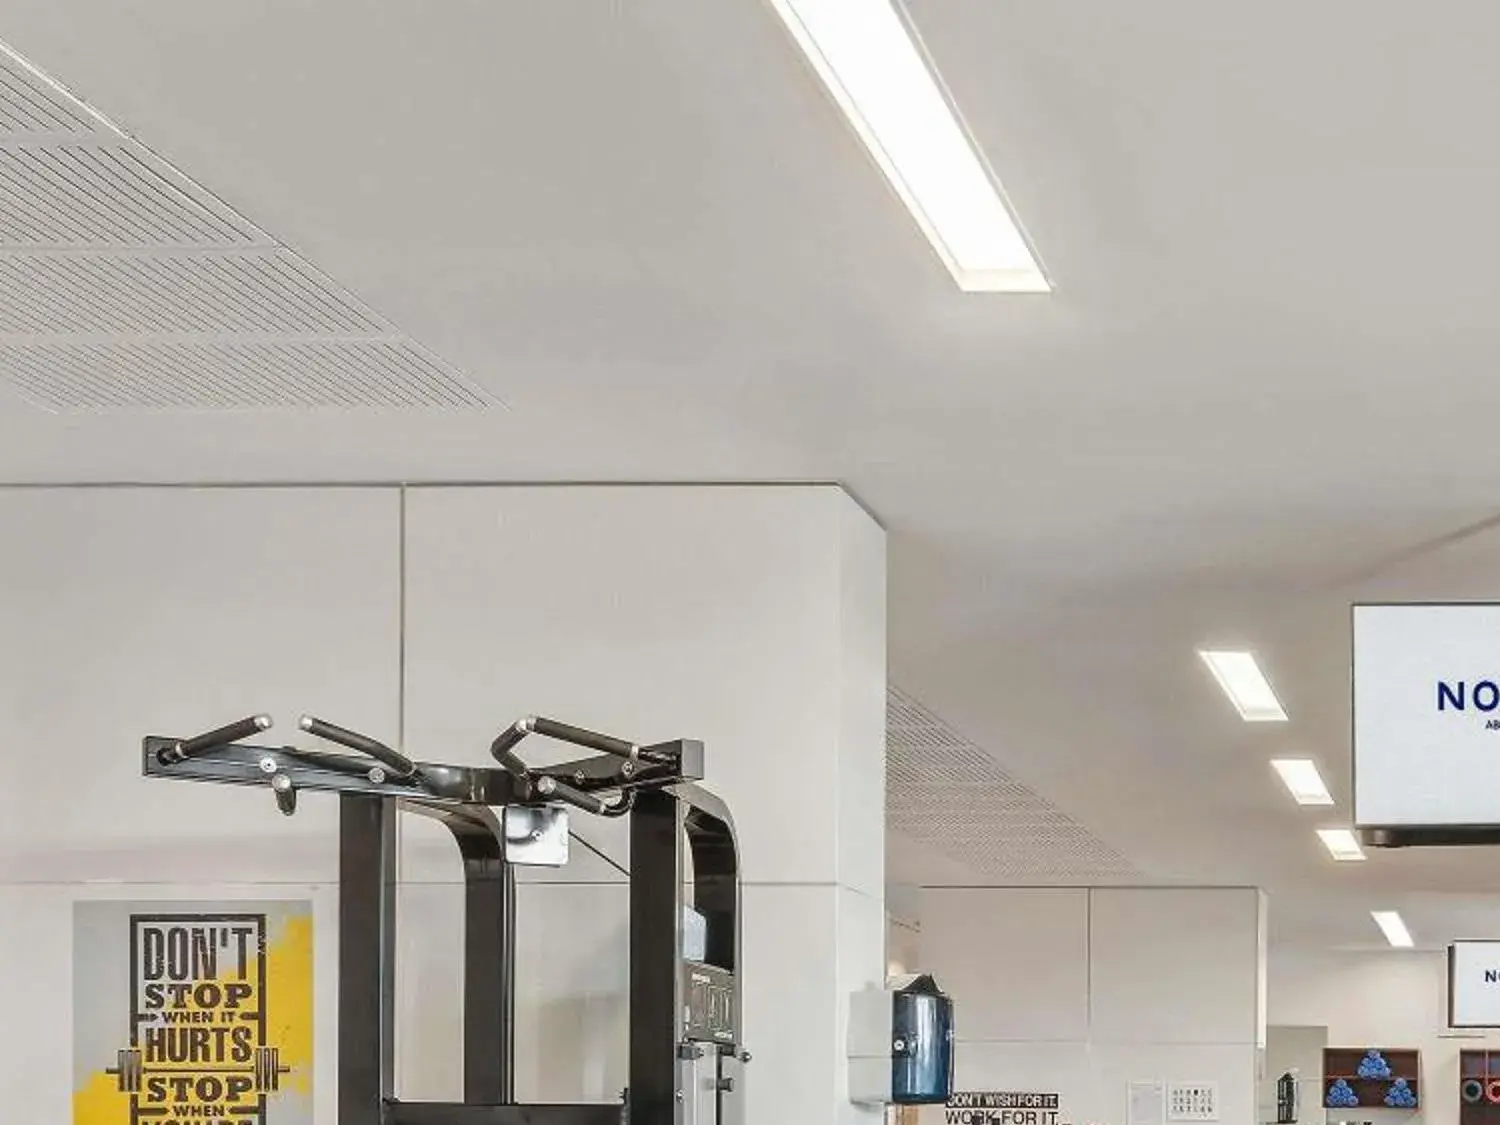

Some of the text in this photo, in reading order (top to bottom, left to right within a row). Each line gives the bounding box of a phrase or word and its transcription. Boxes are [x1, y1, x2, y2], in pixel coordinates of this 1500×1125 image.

[143, 926, 254, 981] DON'T
[145, 983, 253, 1009] STOP
[161, 1011, 236, 1024] WHEN IT
[145, 1026, 252, 1063] HURTS
[147, 1076, 253, 1103] STOP
[1017, 1093, 1042, 1108] FOR
[173, 1105, 226, 1118] WHEN
[1001, 1110, 1037, 1125] FOR
